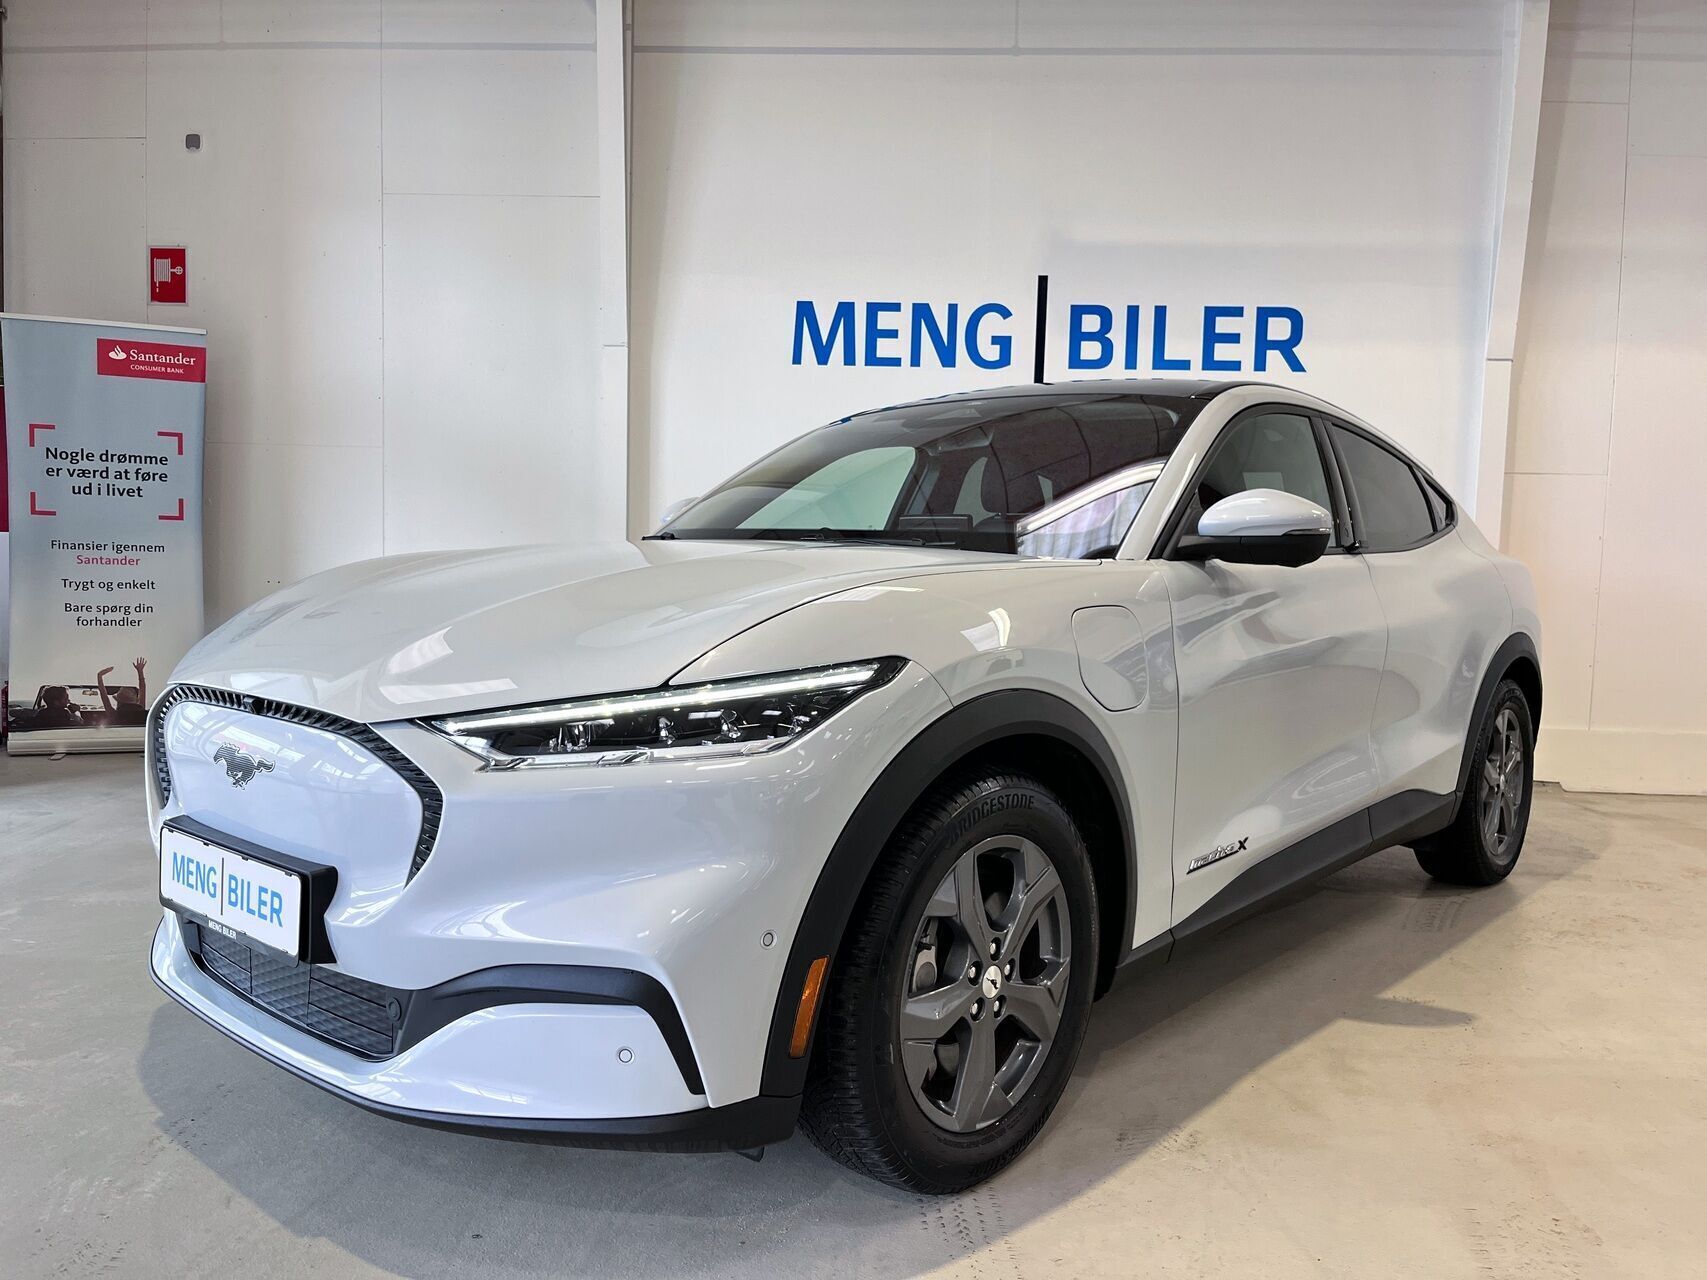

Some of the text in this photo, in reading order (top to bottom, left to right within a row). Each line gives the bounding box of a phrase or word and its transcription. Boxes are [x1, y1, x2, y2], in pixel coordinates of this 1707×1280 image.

[791, 300, 1307, 373] MENG BILER
[129, 349, 196, 366] Santander
[130, 364, 184, 374] CONSUMER BANK
[45, 447, 169, 466] Nogle drømme
[45, 466, 168, 482] er værd at føre
[71, 483, 144, 498] ud i livet
[50, 539, 165, 554] Finansier igennem
[76, 555, 141, 566] Santander
[61, 578, 156, 591] Trygt og enkelt
[64, 602, 154, 615] Bare spørg din
[76, 616, 142, 627] forhandler
[172, 851, 283, 928] MENG BILER
[208, 919, 237, 940] MENG BILER
